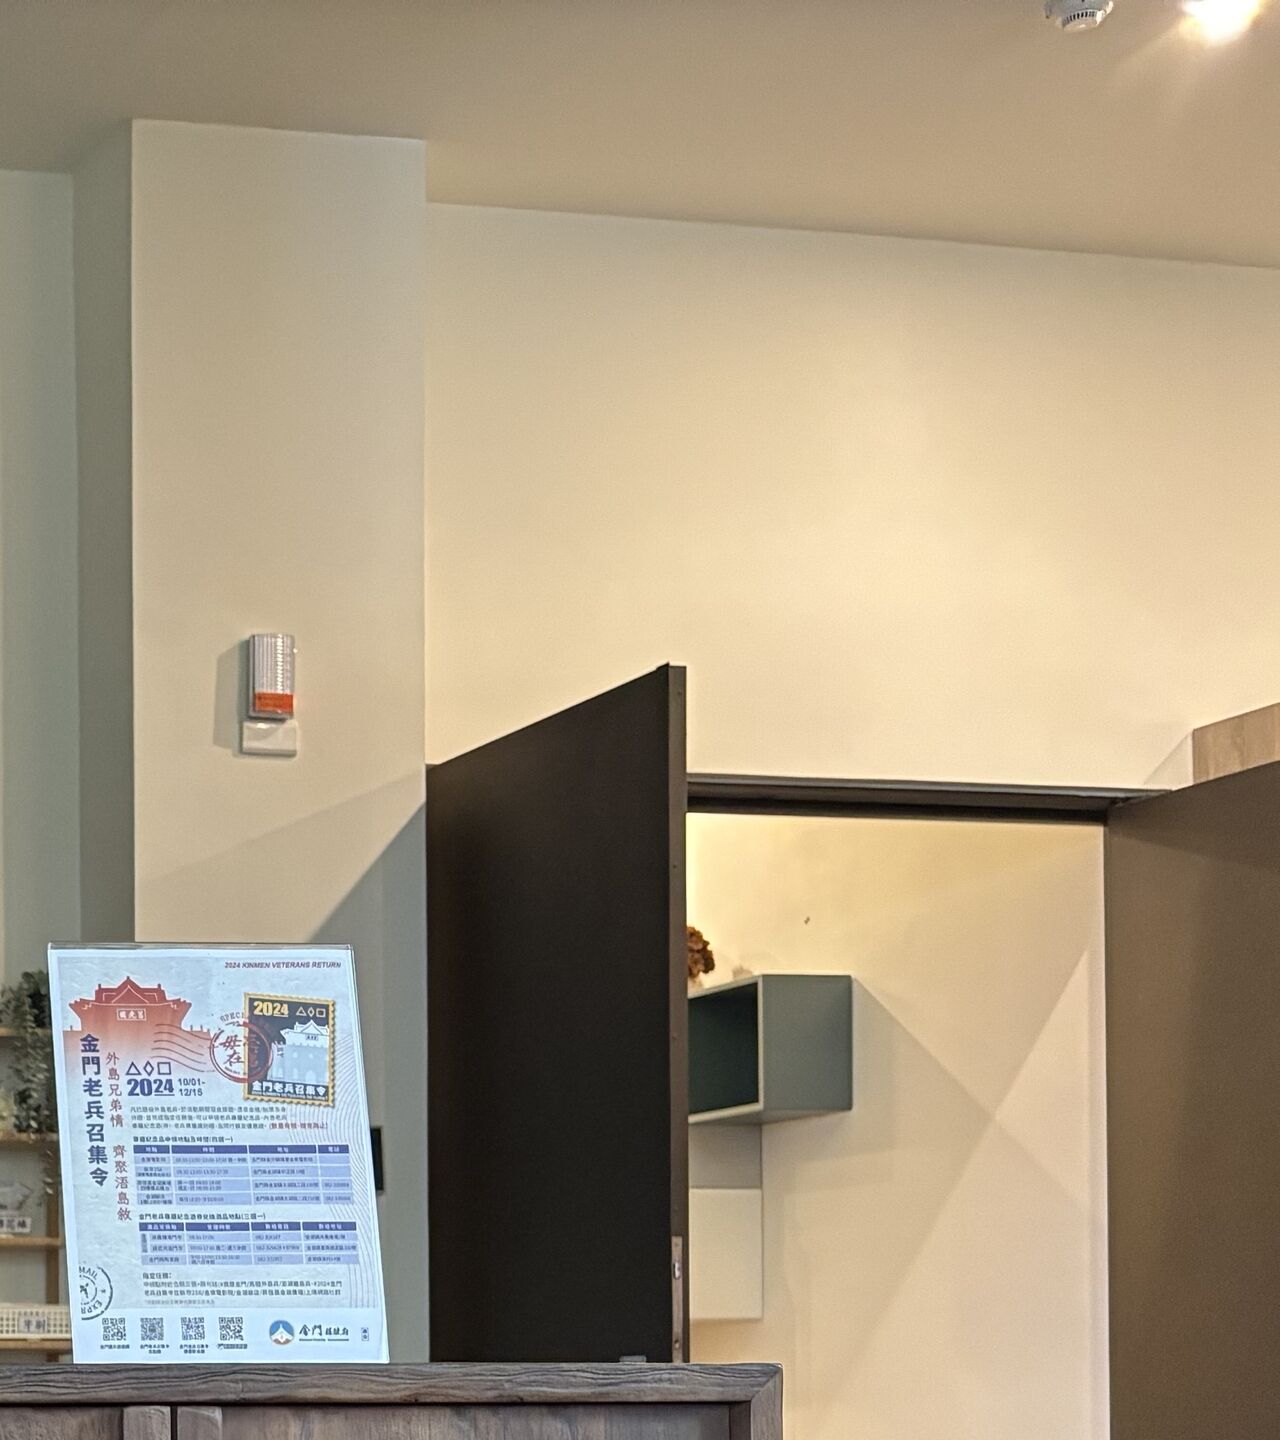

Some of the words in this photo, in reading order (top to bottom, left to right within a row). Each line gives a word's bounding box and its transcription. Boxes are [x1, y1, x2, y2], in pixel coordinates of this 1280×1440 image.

[272, 961, 311, 969] VETERANS
[312, 961, 342, 969] RETURN
[253, 1001, 289, 1016] 2024
[106, 1052, 125, 1128] 外島兄弟情
[127, 1078, 175, 1097] 2024
[178, 1078, 206, 1087] 10/01-
[80, 1034, 109, 1187] 金門老兵召集令
